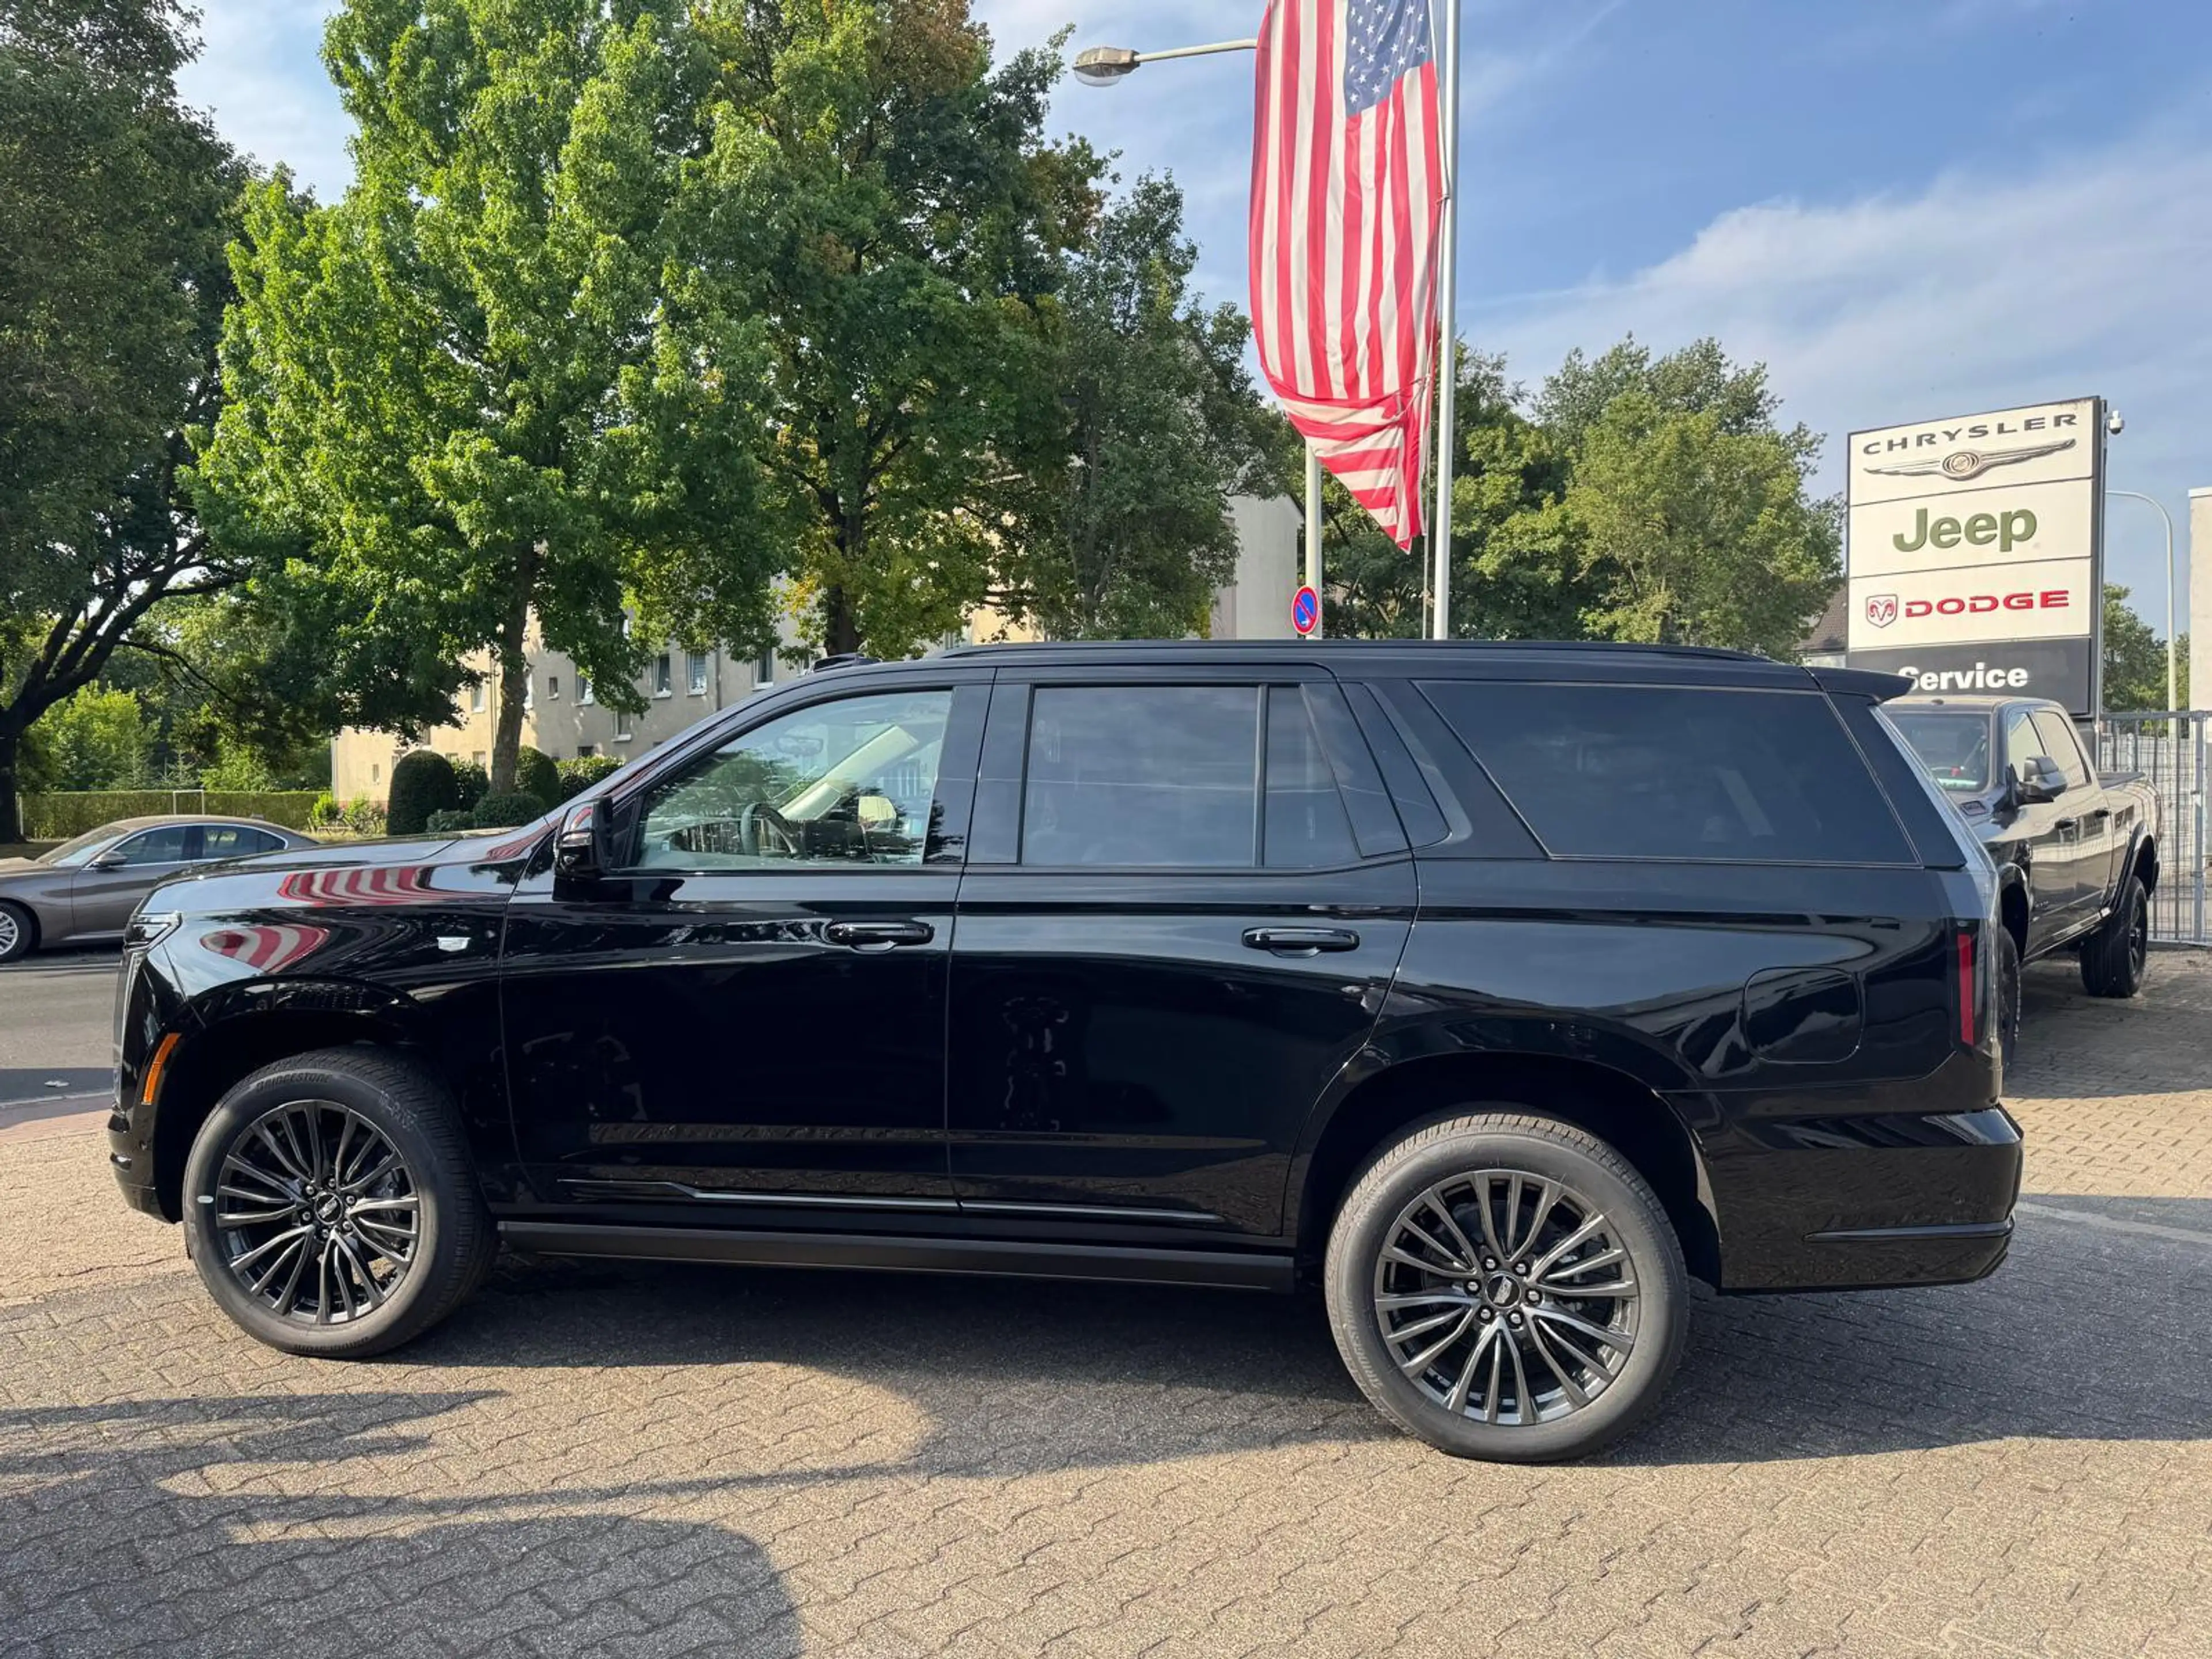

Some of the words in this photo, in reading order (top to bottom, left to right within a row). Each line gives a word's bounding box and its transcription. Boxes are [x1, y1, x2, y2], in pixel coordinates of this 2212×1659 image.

[1863, 414, 2077, 454] CHRYSLER
[1892, 508, 2037, 552] Jeep
[1905, 590, 2069, 618] DODGE
[1898, 662, 2028, 691] Service
